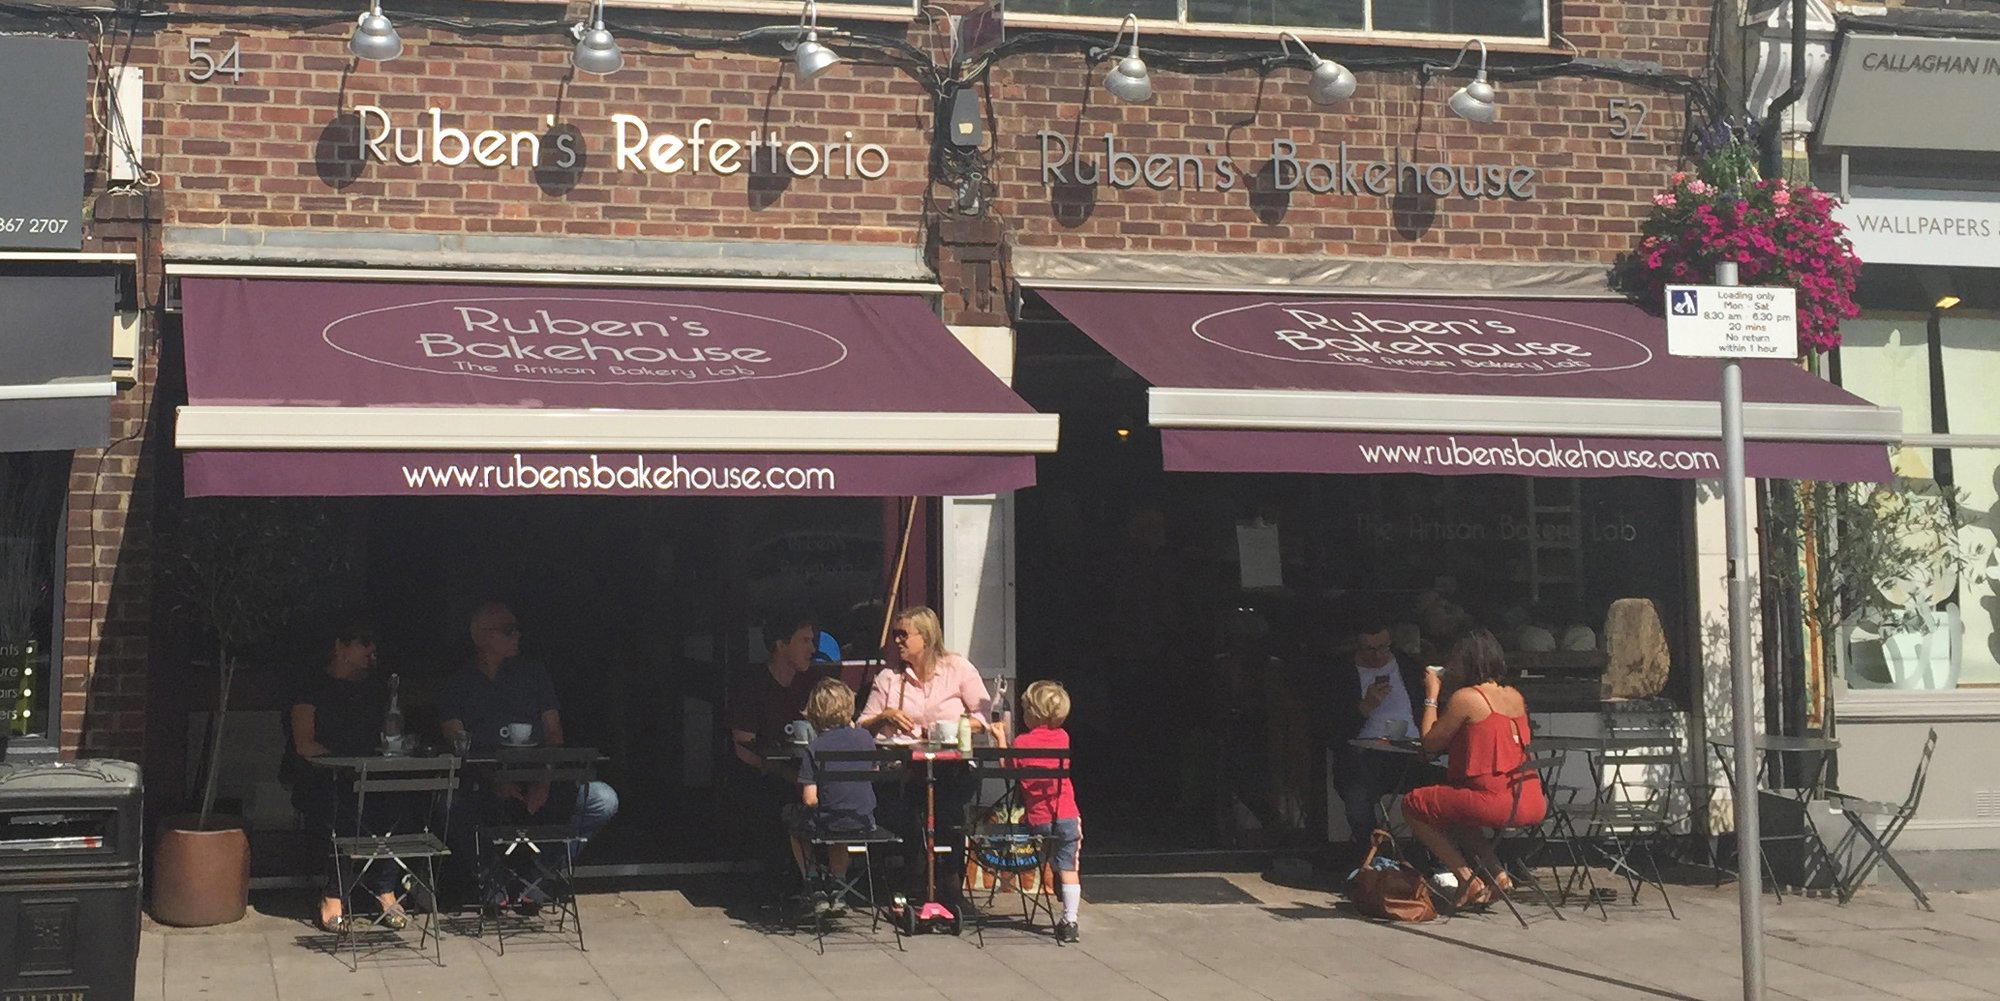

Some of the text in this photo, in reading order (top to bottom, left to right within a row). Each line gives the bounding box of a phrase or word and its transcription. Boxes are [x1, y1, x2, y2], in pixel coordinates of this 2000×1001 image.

[187, 37, 245, 83] 54
[1862, 52, 1980, 75] CALLAGHAN
[1608, 99, 1650, 139] 52
[354, 104, 890, 179] Ruben's Refettorio
[1037, 130, 1537, 199] Ruben's Bakehouse
[29, 218, 69, 233] 2707
[1856, 214, 1991, 238] WALLPAPERS
[1718, 291, 1775, 301] Loading only
[1724, 302, 1770, 310] Mon Sat
[454, 306, 710, 338] Ruben's
[1282, 308, 1517, 335] Ruben's
[1703, 311, 1724, 320] 8.30
[1752, 312, 1773, 321] 6.30
[1776, 314, 1791, 322] pm
[1728, 322, 1767, 331] 20 mins
[416, 332, 772, 364] Bakehouse
[1274, 329, 1592, 357] Bakehouse
[1718, 343, 1747, 352] within
[1757, 344, 1778, 353] hour
[1726, 333, 1770, 342] No return
[453, 361, 756, 379] The Artisan Bakery Lab
[1328, 352, 1374, 364] The
[1380, 356, 1456, 368] Artisan
[1461, 358, 1543, 372] Bakery
[1359, 436, 1720, 472] www.rubensbakehouse.com
[402, 453, 836, 490] www.rubensbakehouse.com
[1591, 512, 1639, 542] Lab
